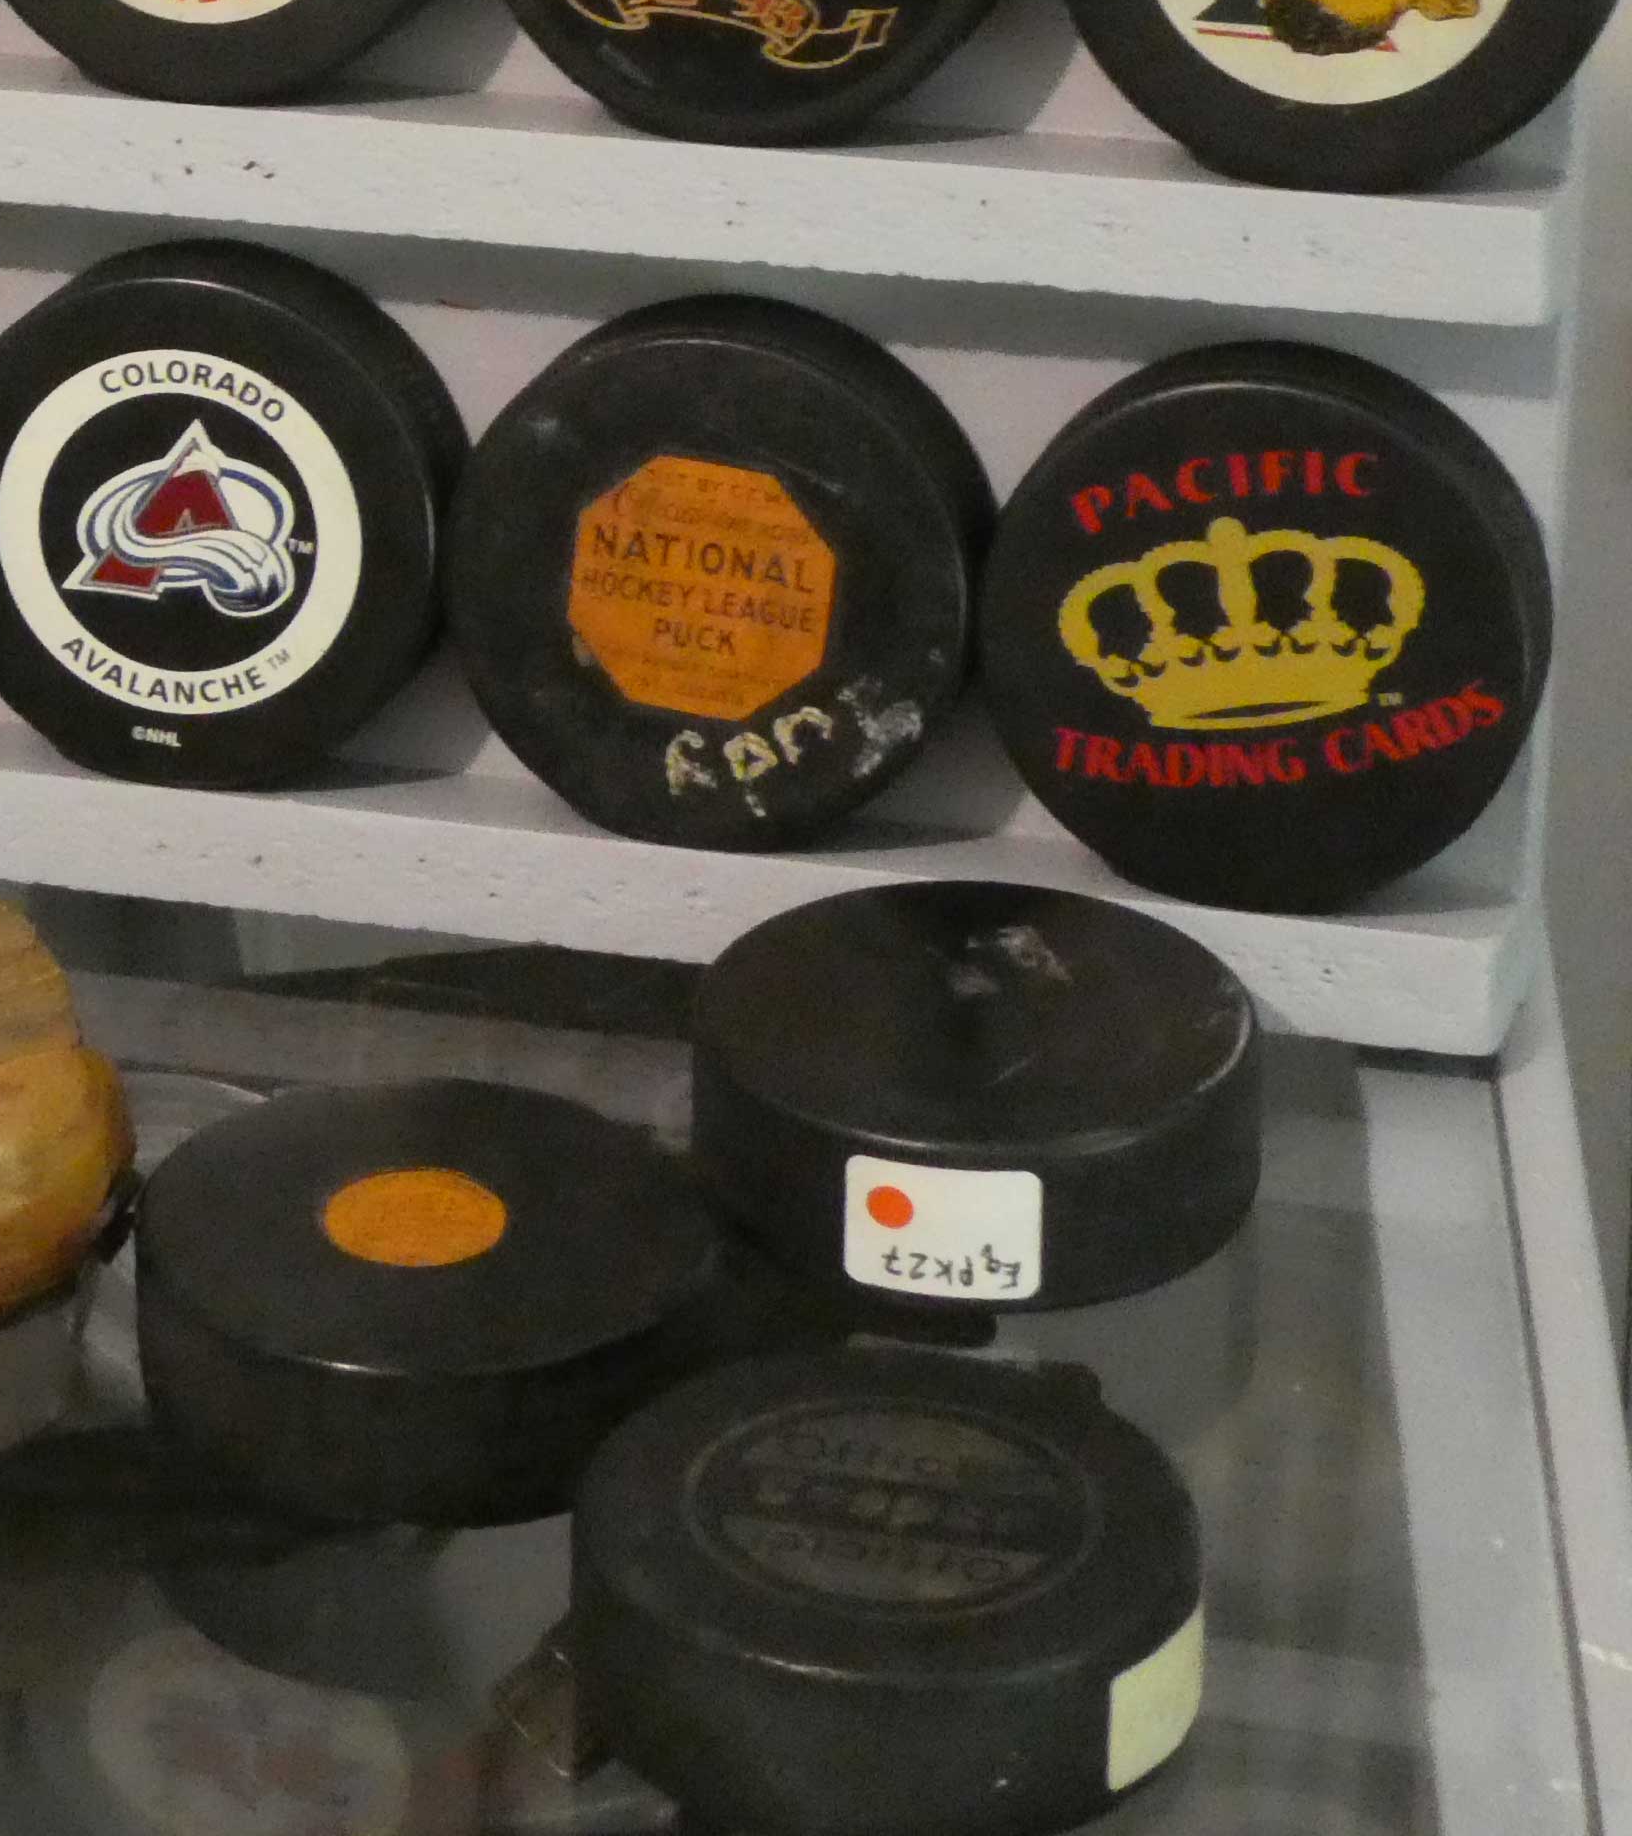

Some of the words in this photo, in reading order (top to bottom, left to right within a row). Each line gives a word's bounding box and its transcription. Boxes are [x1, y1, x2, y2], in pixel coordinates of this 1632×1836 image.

[99, 360, 285, 423] COLORADO
[1071, 450, 1378, 535] PACIFIC
[593, 524, 816, 595] NATIONAL
[581, 568, 691, 610] HOCKEY
[703, 588, 816, 634] LEAGUE
[653, 617, 736, 655] PUCK
[61, 637, 267, 705] AVALANCHE
[1054, 726, 1307, 788] TRADING
[1324, 680, 1504, 773] CARDS
